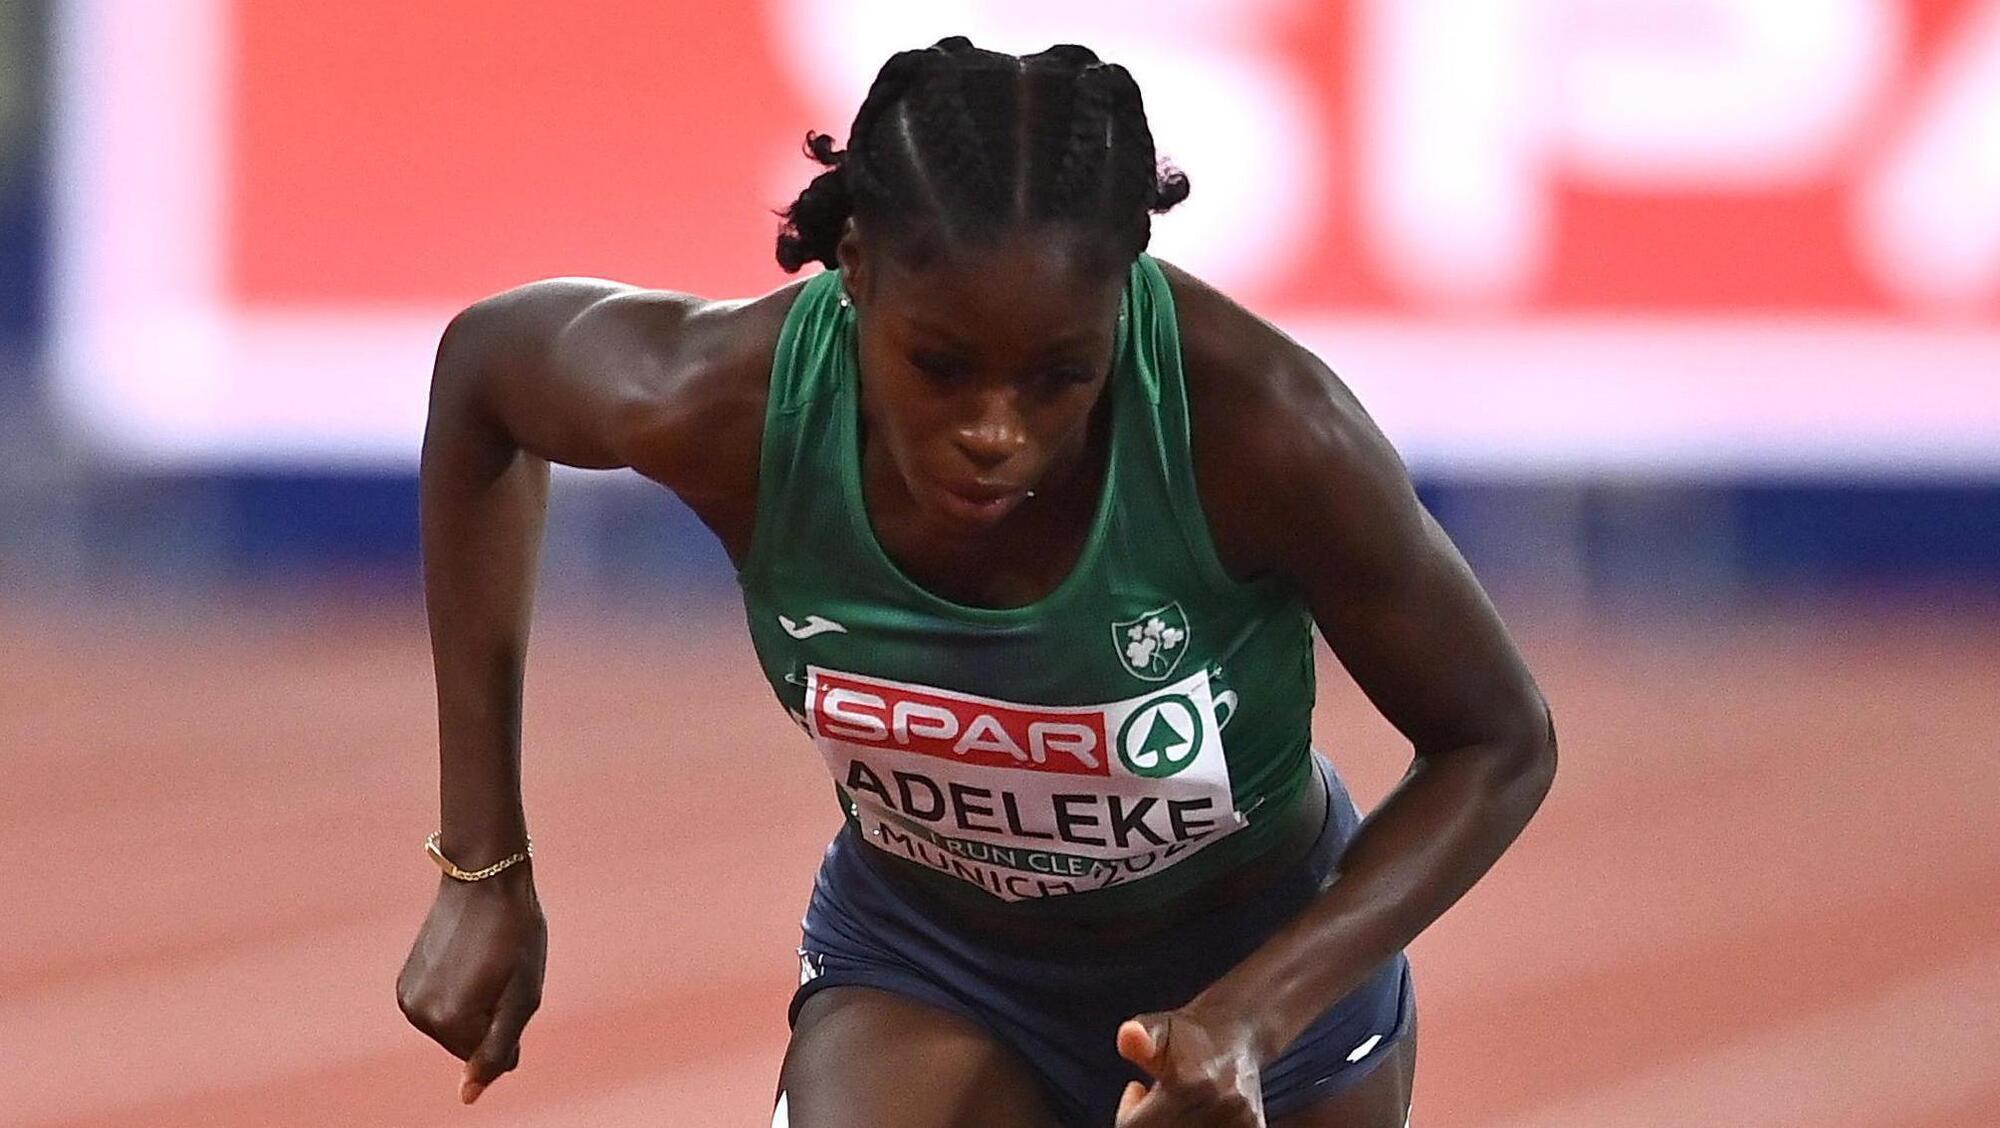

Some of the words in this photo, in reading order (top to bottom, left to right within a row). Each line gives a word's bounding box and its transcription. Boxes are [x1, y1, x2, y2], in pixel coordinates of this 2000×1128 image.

[822, 687, 1100, 769] SPAR
[846, 759, 1215, 848] ADELEKE
[879, 822, 1077, 899] MUNICH
[946, 841, 1016, 868] RUN
